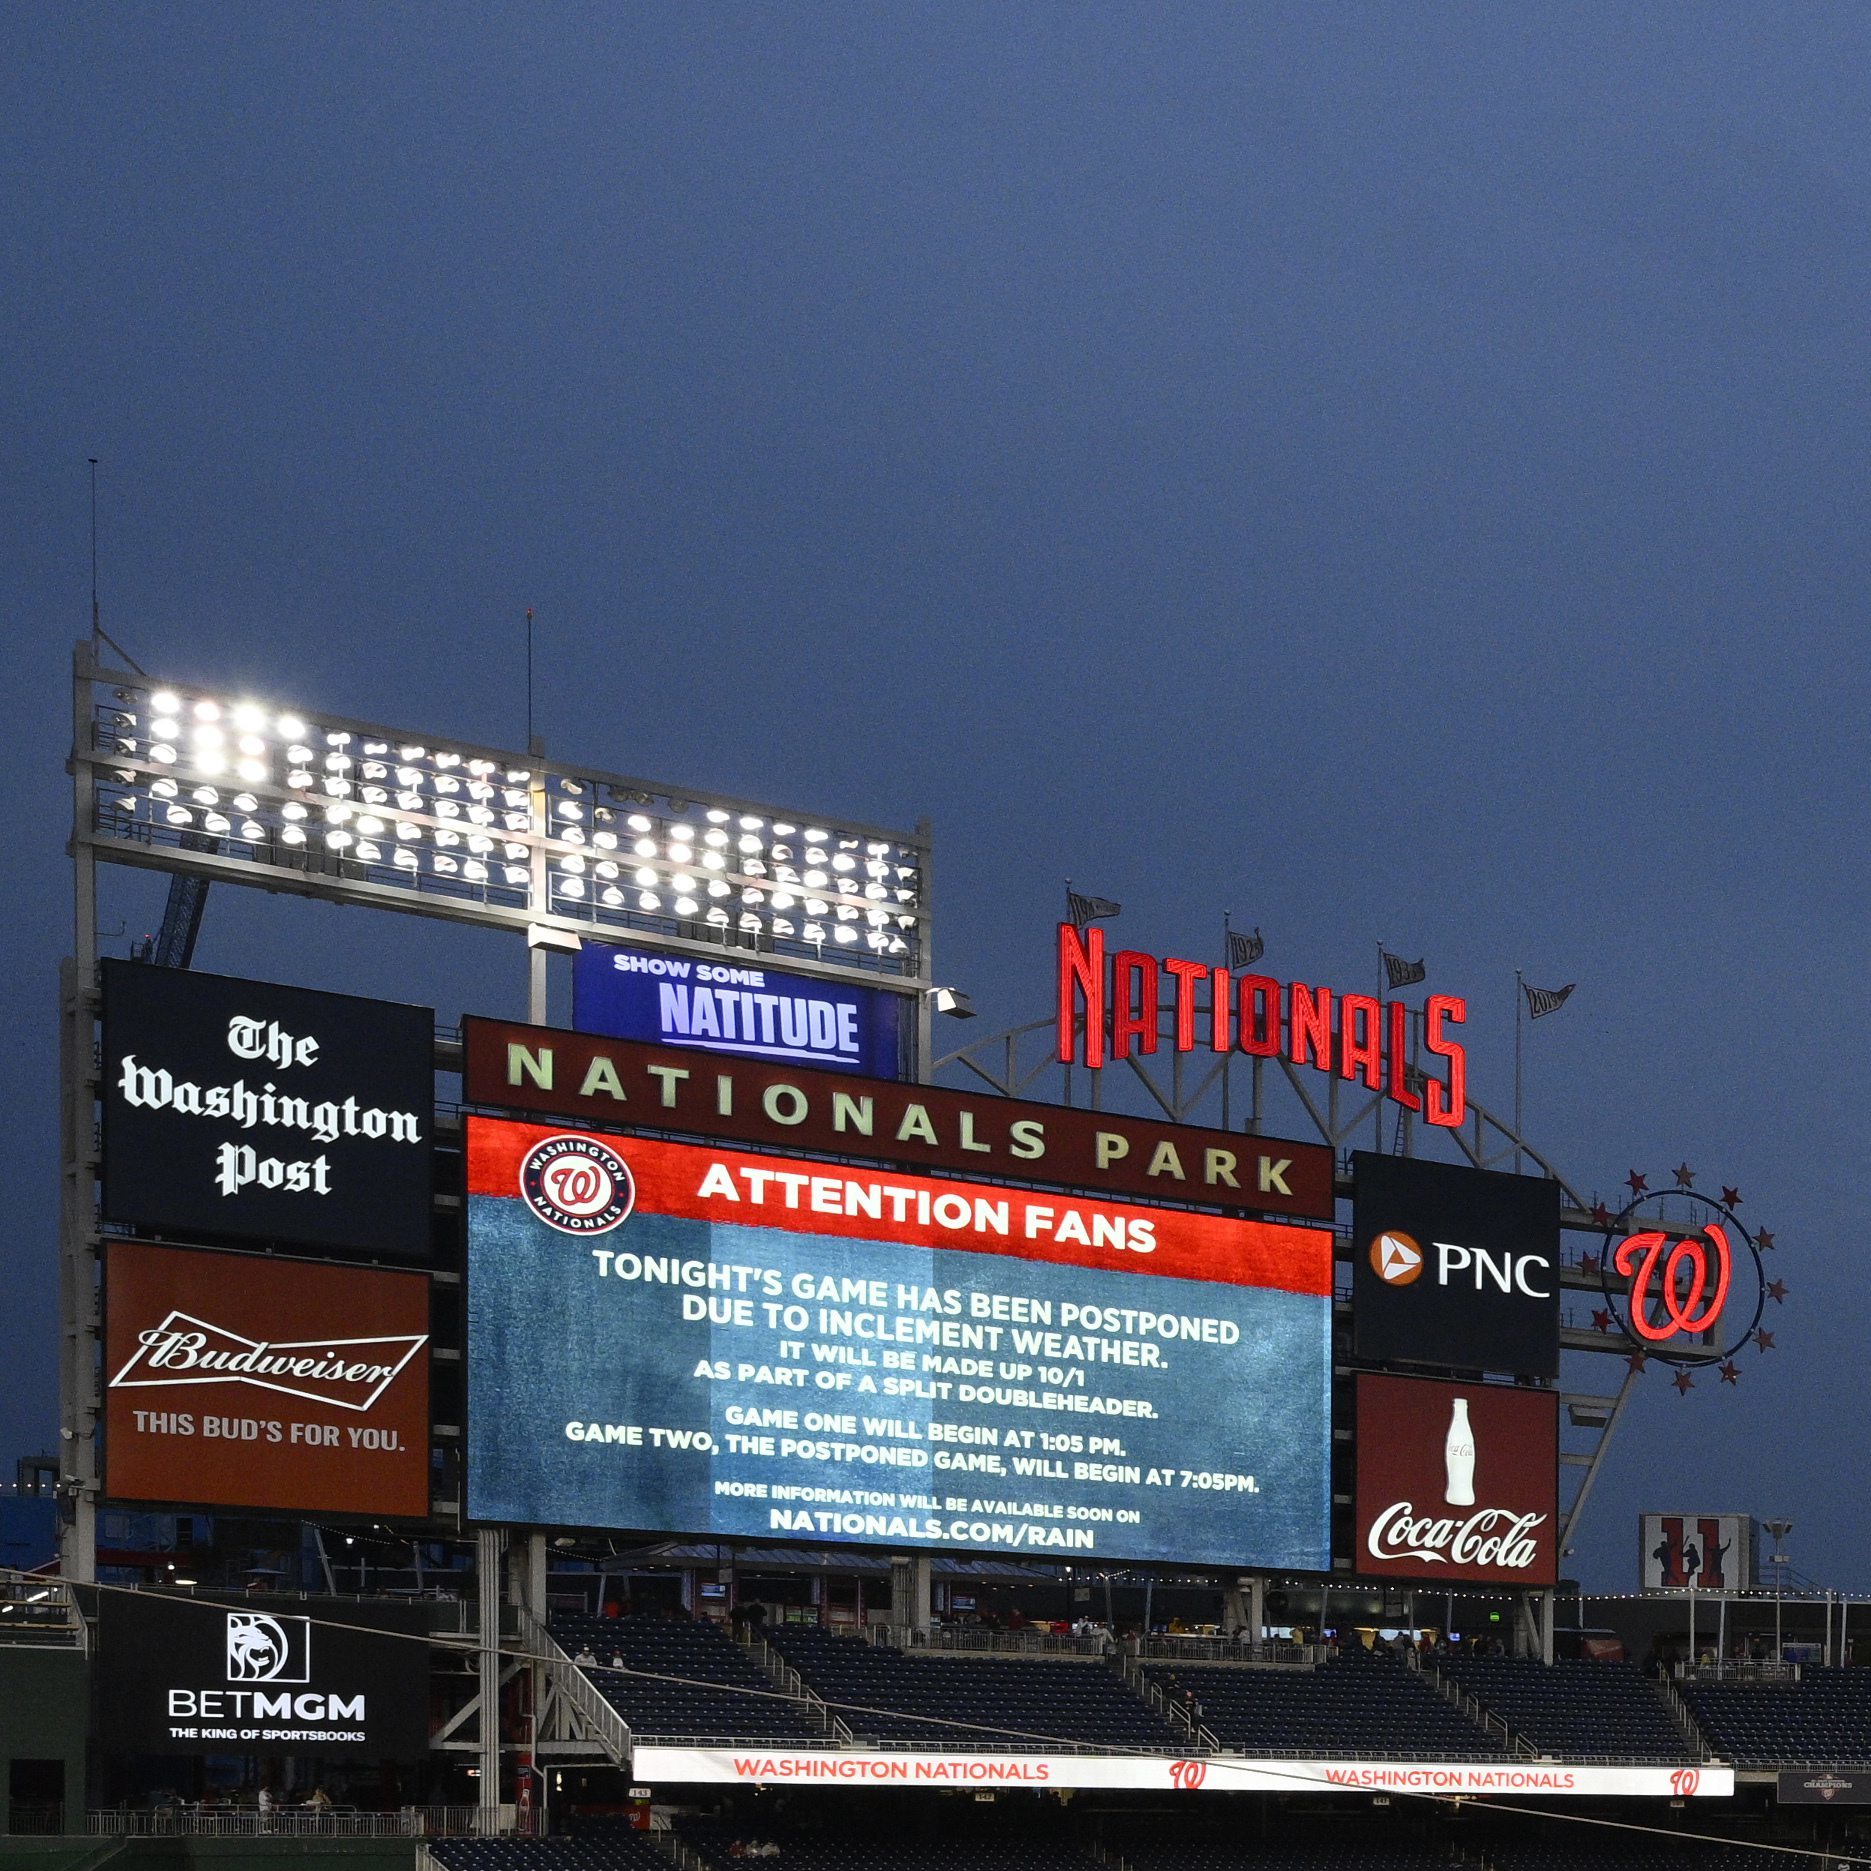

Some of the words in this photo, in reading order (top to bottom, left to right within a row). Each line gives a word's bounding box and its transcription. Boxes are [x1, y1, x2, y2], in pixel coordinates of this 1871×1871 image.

[613, 954, 690, 978] SHOW
[696, 965, 765, 988] SOME
[228, 1015, 320, 1069] The
[659, 982, 860, 1053] NATITUDE
[1056, 921, 1467, 1128] NATIONALS
[118, 1054, 422, 1144] Washington
[507, 1043, 1046, 1160] NATIONALS
[1095, 1131, 1293, 1196] PARK
[215, 1142, 332, 1197] Post
[529, 1142, 625, 1183] WASHINGTON
[534, 1196, 621, 1229] NATIONALS
[697, 1163, 1008, 1236] ATTENTION
[1025, 1204, 1157, 1254] FANS
[592, 1249, 782, 1296] TONIGHT'S
[791, 1273, 888, 1308] GAME
[898, 1284, 961, 1315] HAS
[971, 1292, 1052, 1326] BEEN
[1061, 1302, 1240, 1345] POSTPONED
[1432, 1242, 1550, 1298] PNC
[1615, 1223, 1731, 1341] W
[138, 1329, 395, 1383] Budweiser
[682, 1294, 754, 1327] DUE
[762, 1302, 810, 1332] TO
[819, 1309, 1003, 1352] INCLEMENT
[1011, 1329, 1169, 1369] WEATHER.
[694, 1359, 731, 1381] AS
[737, 1363, 809, 1388] PART
[815, 1370, 852, 1391] OF
[857, 1375, 878, 1394] A
[883, 1377, 953, 1400] SPLIT
[959, 1383, 1159, 1419] DOUBLEHEADER.
[780, 1340, 805, 1359] IT
[811, 1343, 877, 1367] WILL
[883, 1351, 916, 1371] BE
[922, 1354, 994, 1378] MADE
[999, 1363, 1033, 1381] UP
[1038, 1366, 1085, 1388] 10/1
[133, 1410, 195, 1436] THIS
[203, 1415, 283, 1443] BUD'S
[290, 1423, 339, 1447] FOR
[347, 1427, 405, 1452] YOU.
[565, 1421, 643, 1446] GAME
[649, 1428, 720, 1455] TWO,
[725, 1434, 775, 1457] THE
[781, 1439, 928, 1468] POSTPONED
[934, 1451, 1007, 1477] GAME,
[1012, 1457, 1069, 1480] WILL
[1074, 1462, 1141, 1484] BEGIN
[1145, 1468, 1176, 1488] AT
[1180, 1470, 1260, 1494] 7:05PM.
[725, 1406, 798, 1430] GAME
[804, 1413, 857, 1434] ONE
[863, 1417, 922, 1440] WILL
[928, 1423, 998, 1446] BEGIN
[1004, 1430, 1035, 1449] AT
[1040, 1433, 1084, 1452] 1:05
[1089, 1437, 1127, 1457] PM.
[715, 1481, 767, 1498] MORE
[772, 1484, 896, 1507] INFORMATION
[901, 1494, 942, 1511] WILL
[945, 1498, 967, 1512] BE
[971, 1499, 1063, 1520] AVAILABLE
[1067, 1505, 1113, 1522] SOON
[1116, 1509, 1140, 1524] ON
[770, 1508, 1094, 1549] NATIONALS.COM/RAIN
[1368, 1501, 1548, 1569] Coca-Cola
[168, 1689, 365, 1722] BETMGM
[169, 1727, 198, 1738] THE
[201, 1728, 237, 1740] KING
[240, 1729, 260, 1740] OF
[262, 1730, 365, 1741] SPORTSBOOKS
[734, 1758, 907, 1779] WASHINGTON
[915, 1761, 1049, 1780] NATIONALS
[1325, 1768, 1462, 1787] WASHINGTON
[1468, 1771, 1575, 1788] NATIONALS
